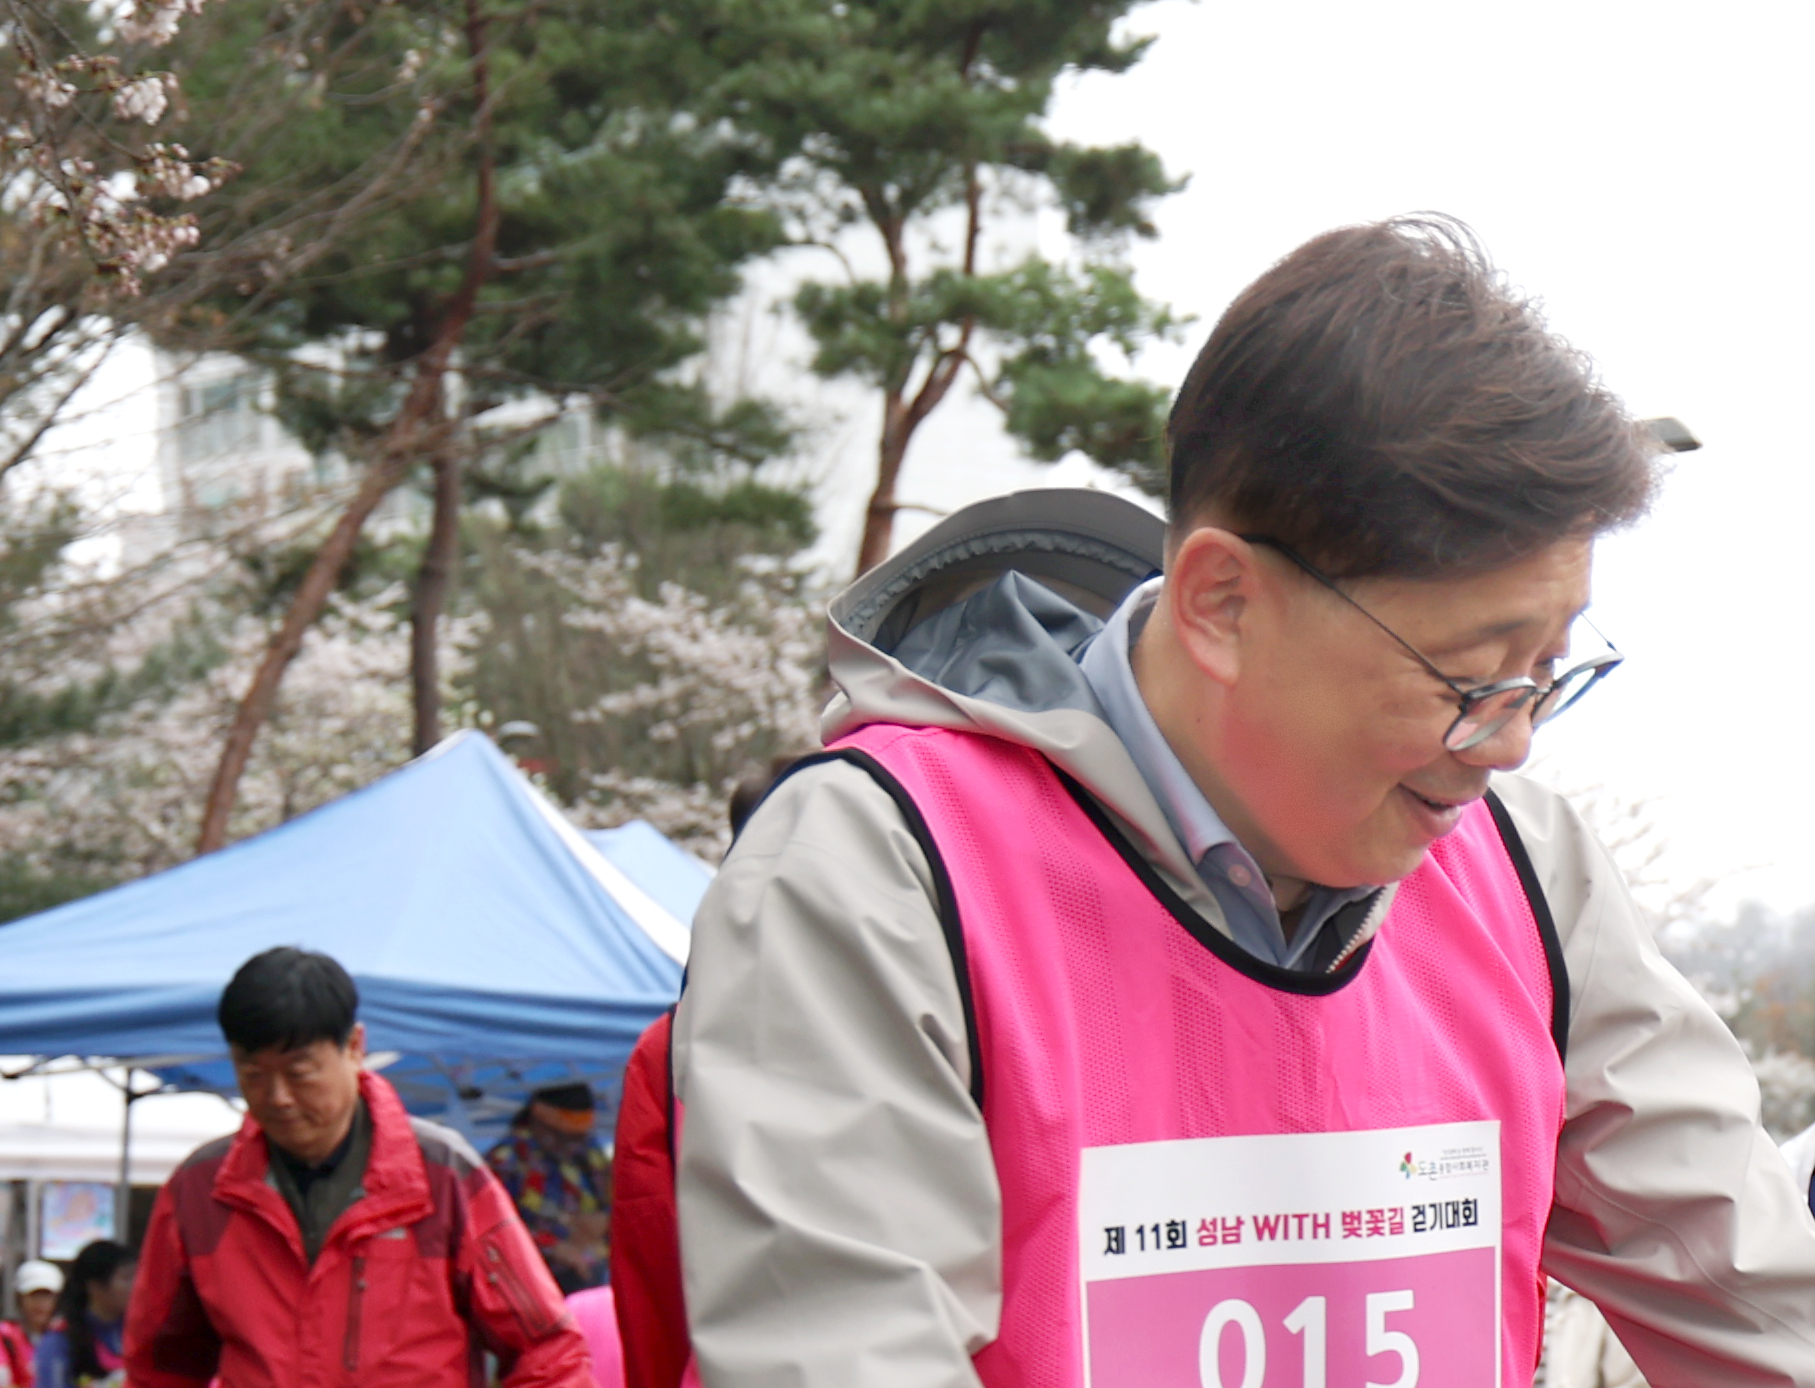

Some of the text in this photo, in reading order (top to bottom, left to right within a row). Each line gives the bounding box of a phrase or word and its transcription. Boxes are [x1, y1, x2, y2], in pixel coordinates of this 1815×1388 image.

[1103, 1198, 1479, 1256] 제 11회 성남 WITH 벚꽃길 걷기대회
